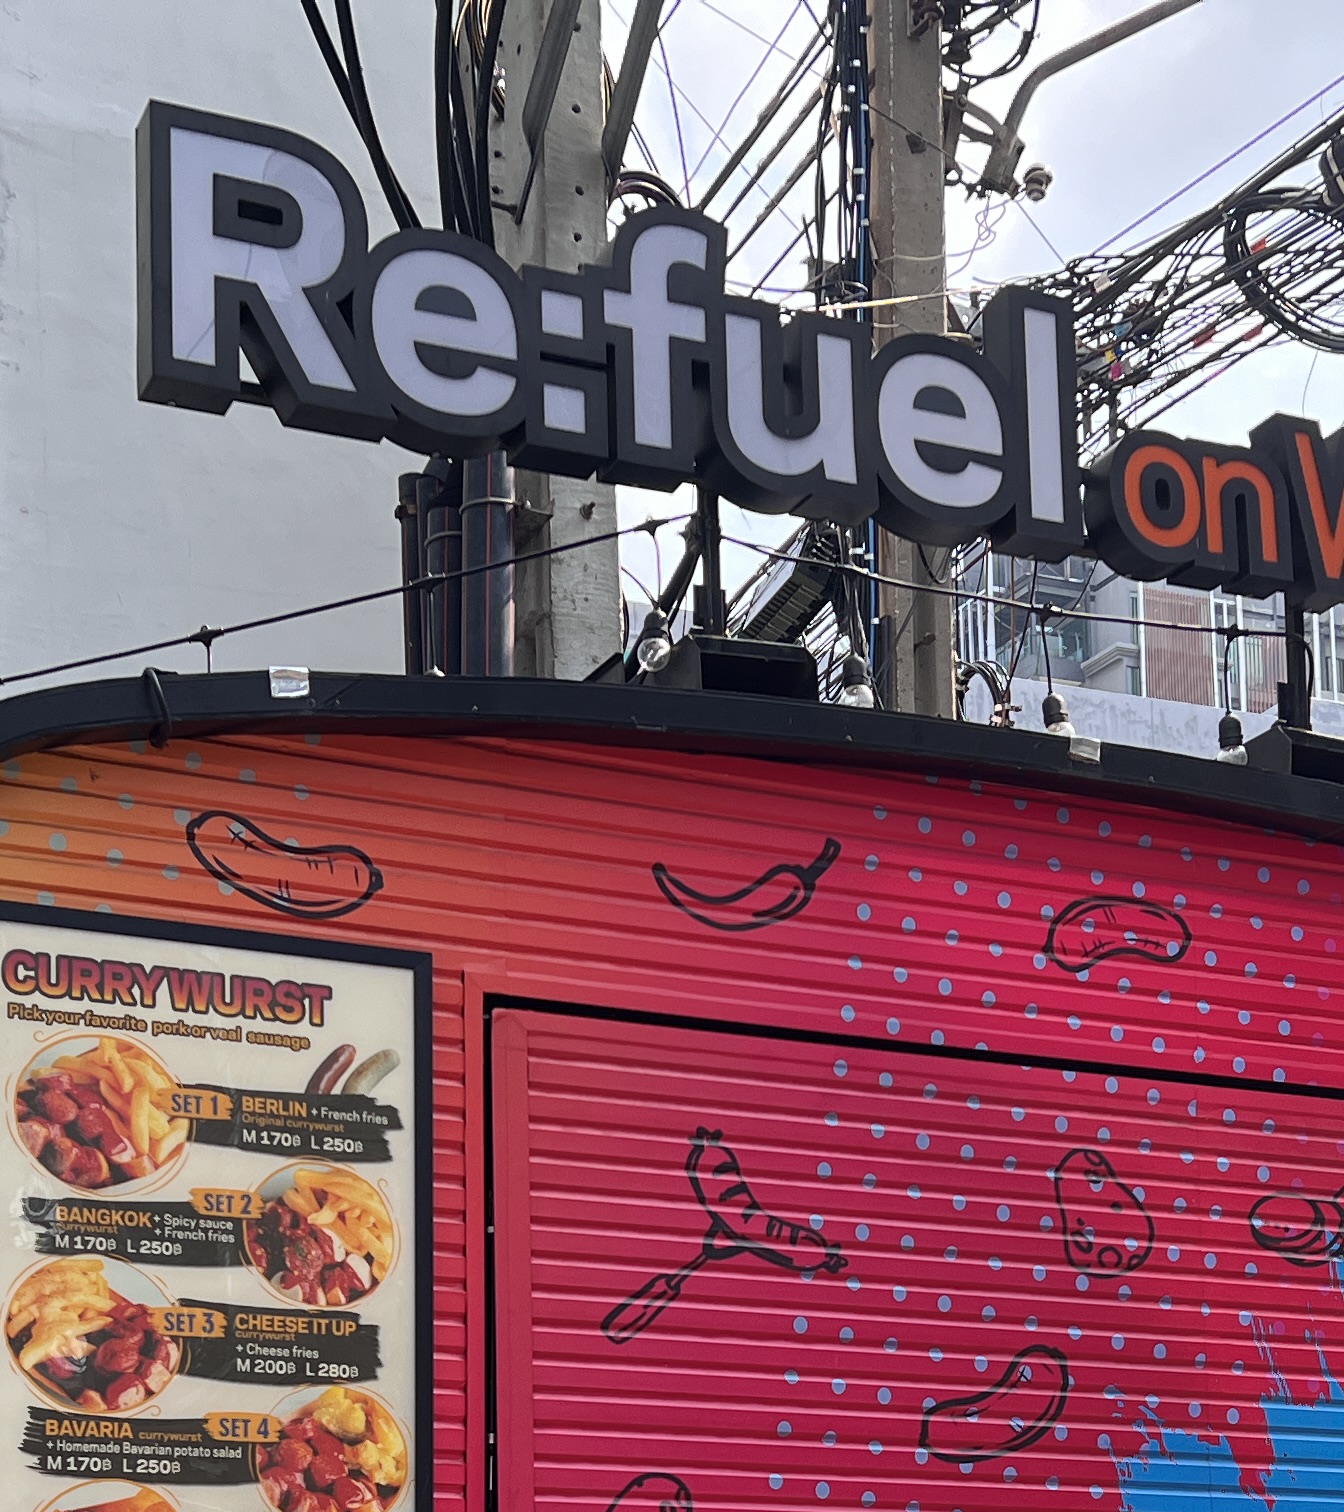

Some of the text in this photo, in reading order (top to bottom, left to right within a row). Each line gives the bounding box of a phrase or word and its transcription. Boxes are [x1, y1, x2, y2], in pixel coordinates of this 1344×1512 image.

[164, 120, 1068, 528] Re:fuel
[8, 1002, 310, 1051] Pick your favorite pork or veal sausage
[171, 1093, 218, 1116] SET 1
[242, 1096, 388, 1125] BERLIN French fries
[242, 1113, 345, 1133] Original currywurst
[243, 1128, 256, 1144] M
[311, 1136, 320, 1150] L
[204, 1193, 252, 1215] SET 2
[57, 1206, 234, 1230] BANGKOK Spicy sauce
[57, 1235, 69, 1248] M
[127, 1239, 136, 1253] L
[164, 1227, 235, 1243] French fries
[164, 1312, 214, 1334] SET 3
[235, 1313, 356, 1336] CHEESE IT UP
[235, 1330, 296, 1342] currywurst
[246, 1343, 319, 1359] Cheese fries
[236, 1358, 251, 1372] M
[306, 1362, 316, 1376] L
[45, 1418, 270, 1443] BAVARIA currywurst SET 4
[57, 1439, 242, 1459] Homemade Bavarian potato salad
[47, 1456, 62, 1470] M
[123, 1458, 133, 1473] L
